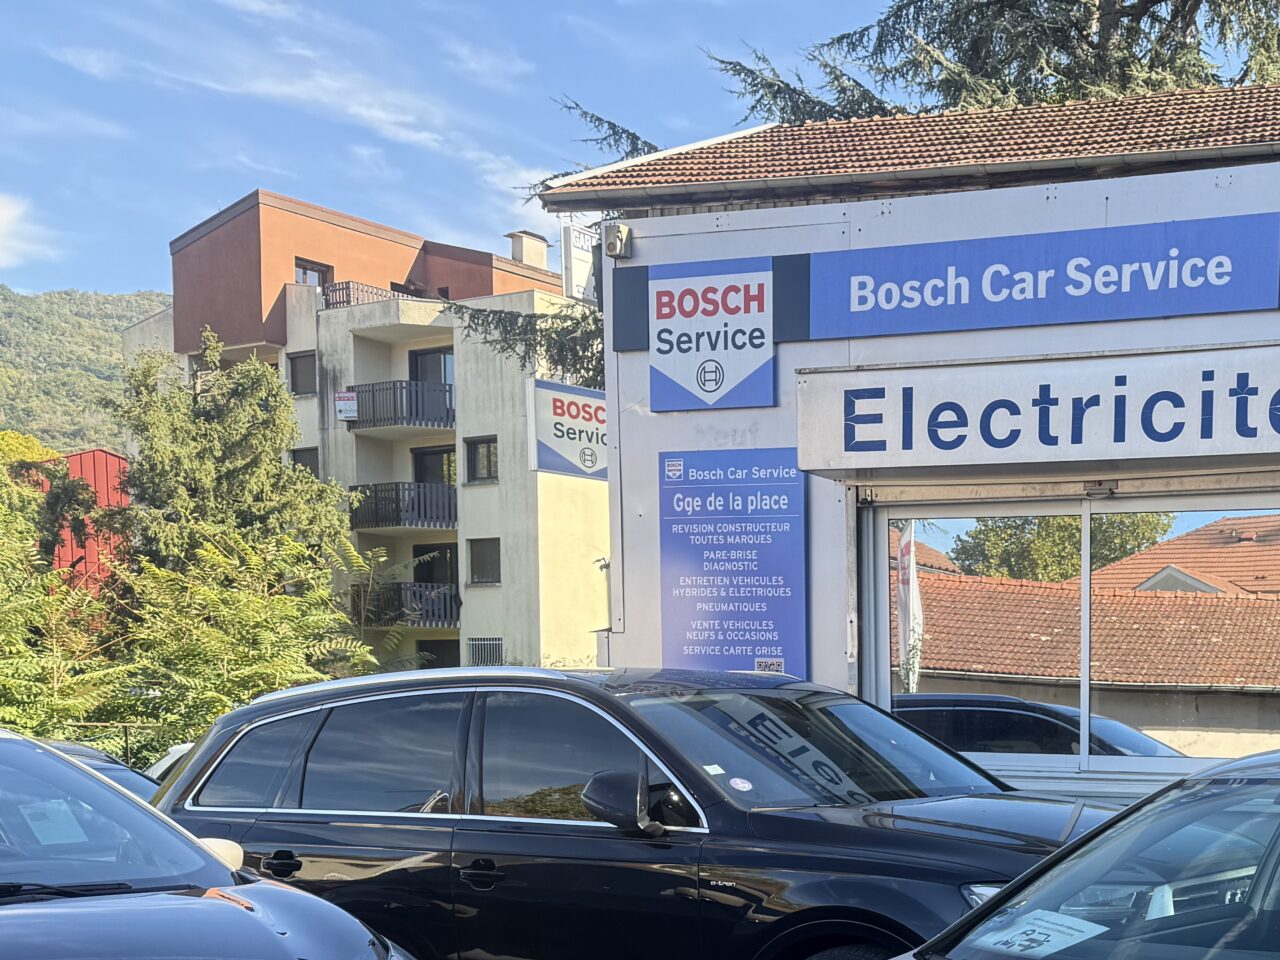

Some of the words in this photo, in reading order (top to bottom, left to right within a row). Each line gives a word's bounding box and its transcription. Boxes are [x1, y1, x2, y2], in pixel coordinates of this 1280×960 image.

[849, 265, 969, 312] Bosch
[981, 263, 1055, 302] Car
[1065, 247, 1233, 296] Service
[655, 282, 765, 320] BOSCH
[655, 322, 766, 355] Service
[552, 397, 606, 424] BOSC
[553, 422, 607, 446] Servic
[688, 468, 724, 480] Bosch
[727, 467, 748, 479] Car
[751, 465, 797, 478] Service
[673, 493, 702, 516] Gge
[706, 492, 724, 511] de
[729, 492, 743, 511] la
[747, 491, 789, 514] place
[672, 524, 714, 533] REVISION
[716, 522, 791, 533] CONSTRUCTEUR
[690, 535, 725, 545] TOUTES
[727, 534, 773, 544] MARQUES
[703, 550, 758, 560] PARE-BRISE
[703, 561, 759, 571] DIAGNOSTIC
[679, 576, 730, 586] ENTRETIEN
[731, 576, 784, 586] VEHICULES
[672, 587, 718, 597] HYBRIDES
[720, 588, 726, 597] &
[729, 587, 792, 597] ELECTRIQUES
[696, 603, 768, 612] PNEUMATIQUES
[691, 620, 721, 630] VENTE
[723, 620, 774, 630] VEHICULES
[686, 631, 716, 641] NEUFS
[717, 631, 724, 641] &
[726, 631, 779, 641] OCCASIONS
[683, 646, 721, 656] SERVICE
[723, 646, 753, 656] CARTE
[755, 646, 783, 656] GRISE
